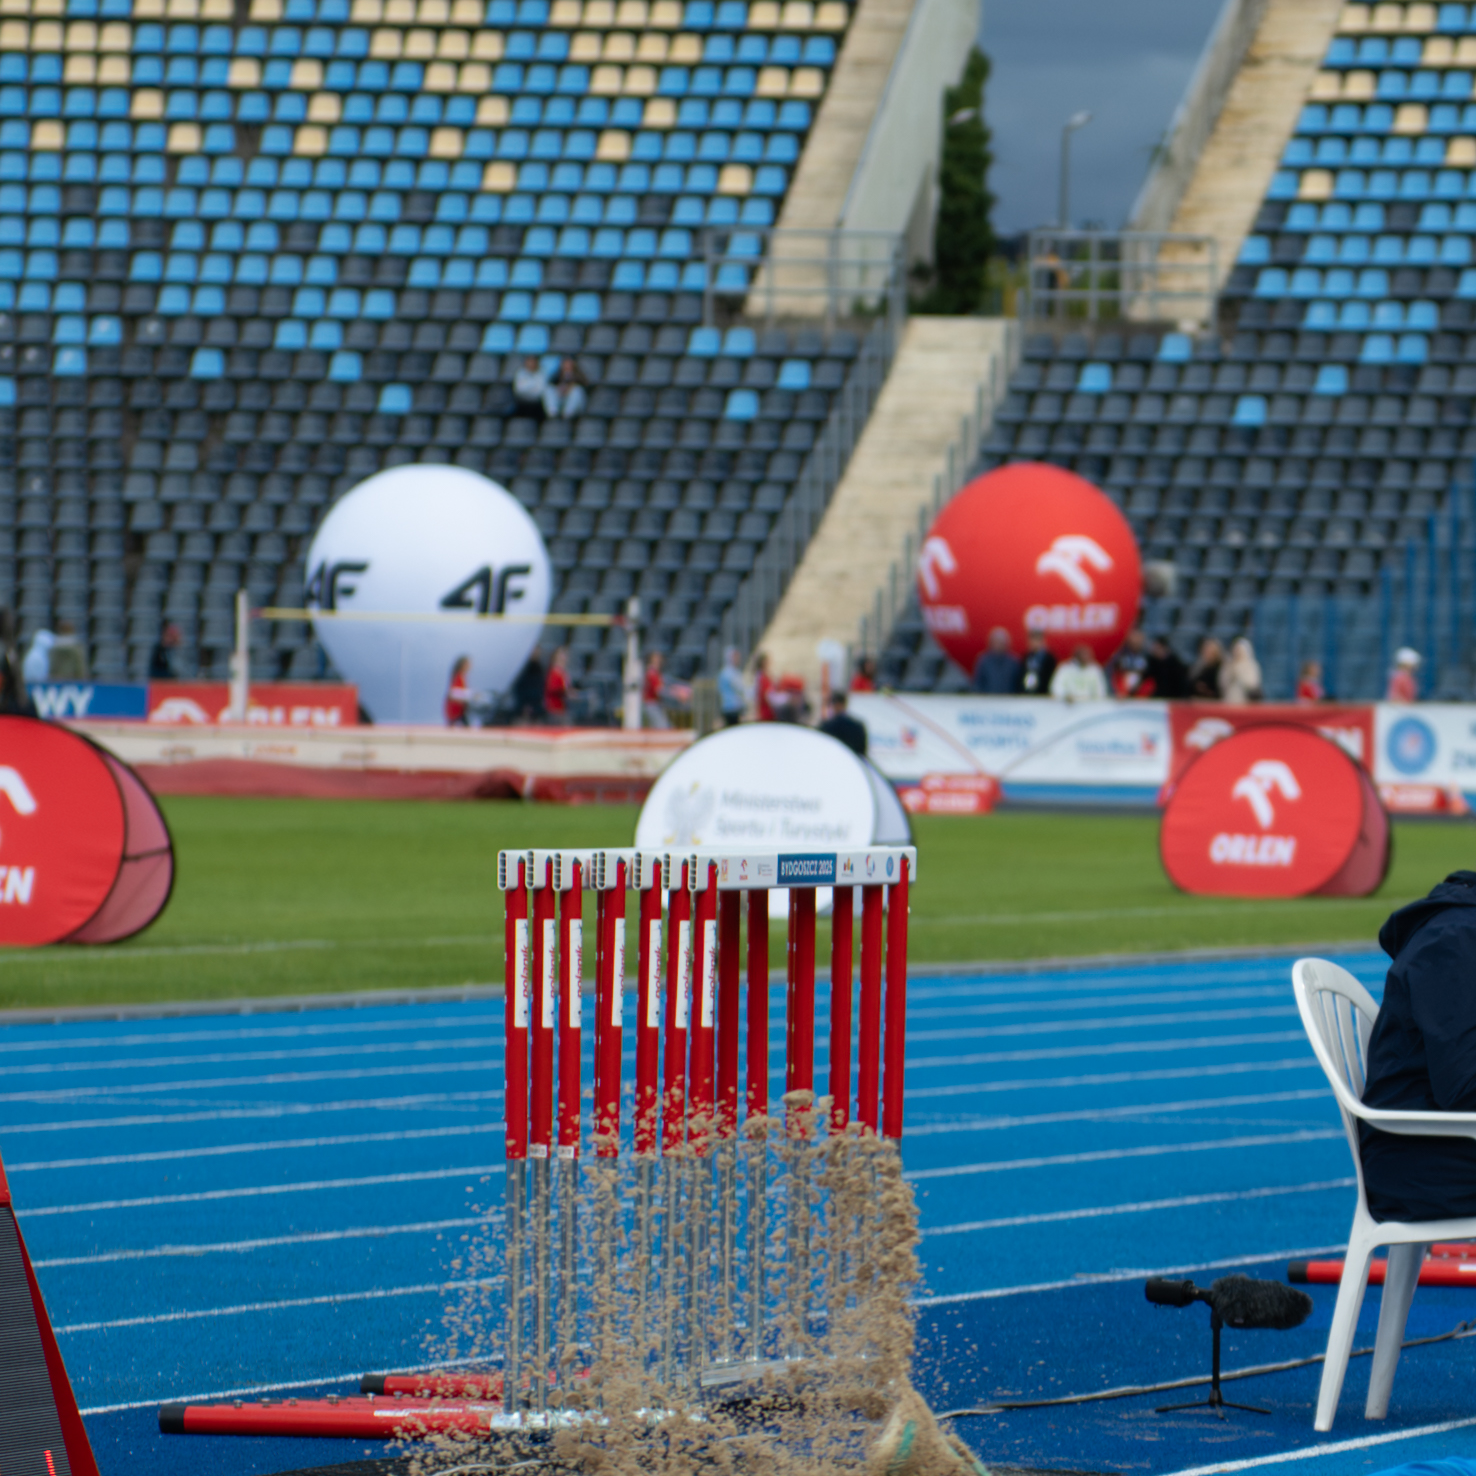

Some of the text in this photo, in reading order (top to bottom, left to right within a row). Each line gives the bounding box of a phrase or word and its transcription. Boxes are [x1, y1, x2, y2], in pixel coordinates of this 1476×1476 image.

[439, 564, 532, 619] 4F
[1024, 602, 1119, 634] ORLEN
[1209, 832, 1297, 866] ORLEN
[780, 860, 818, 877] BYDGOSZCZ
[818, 859, 834, 876] 2025
